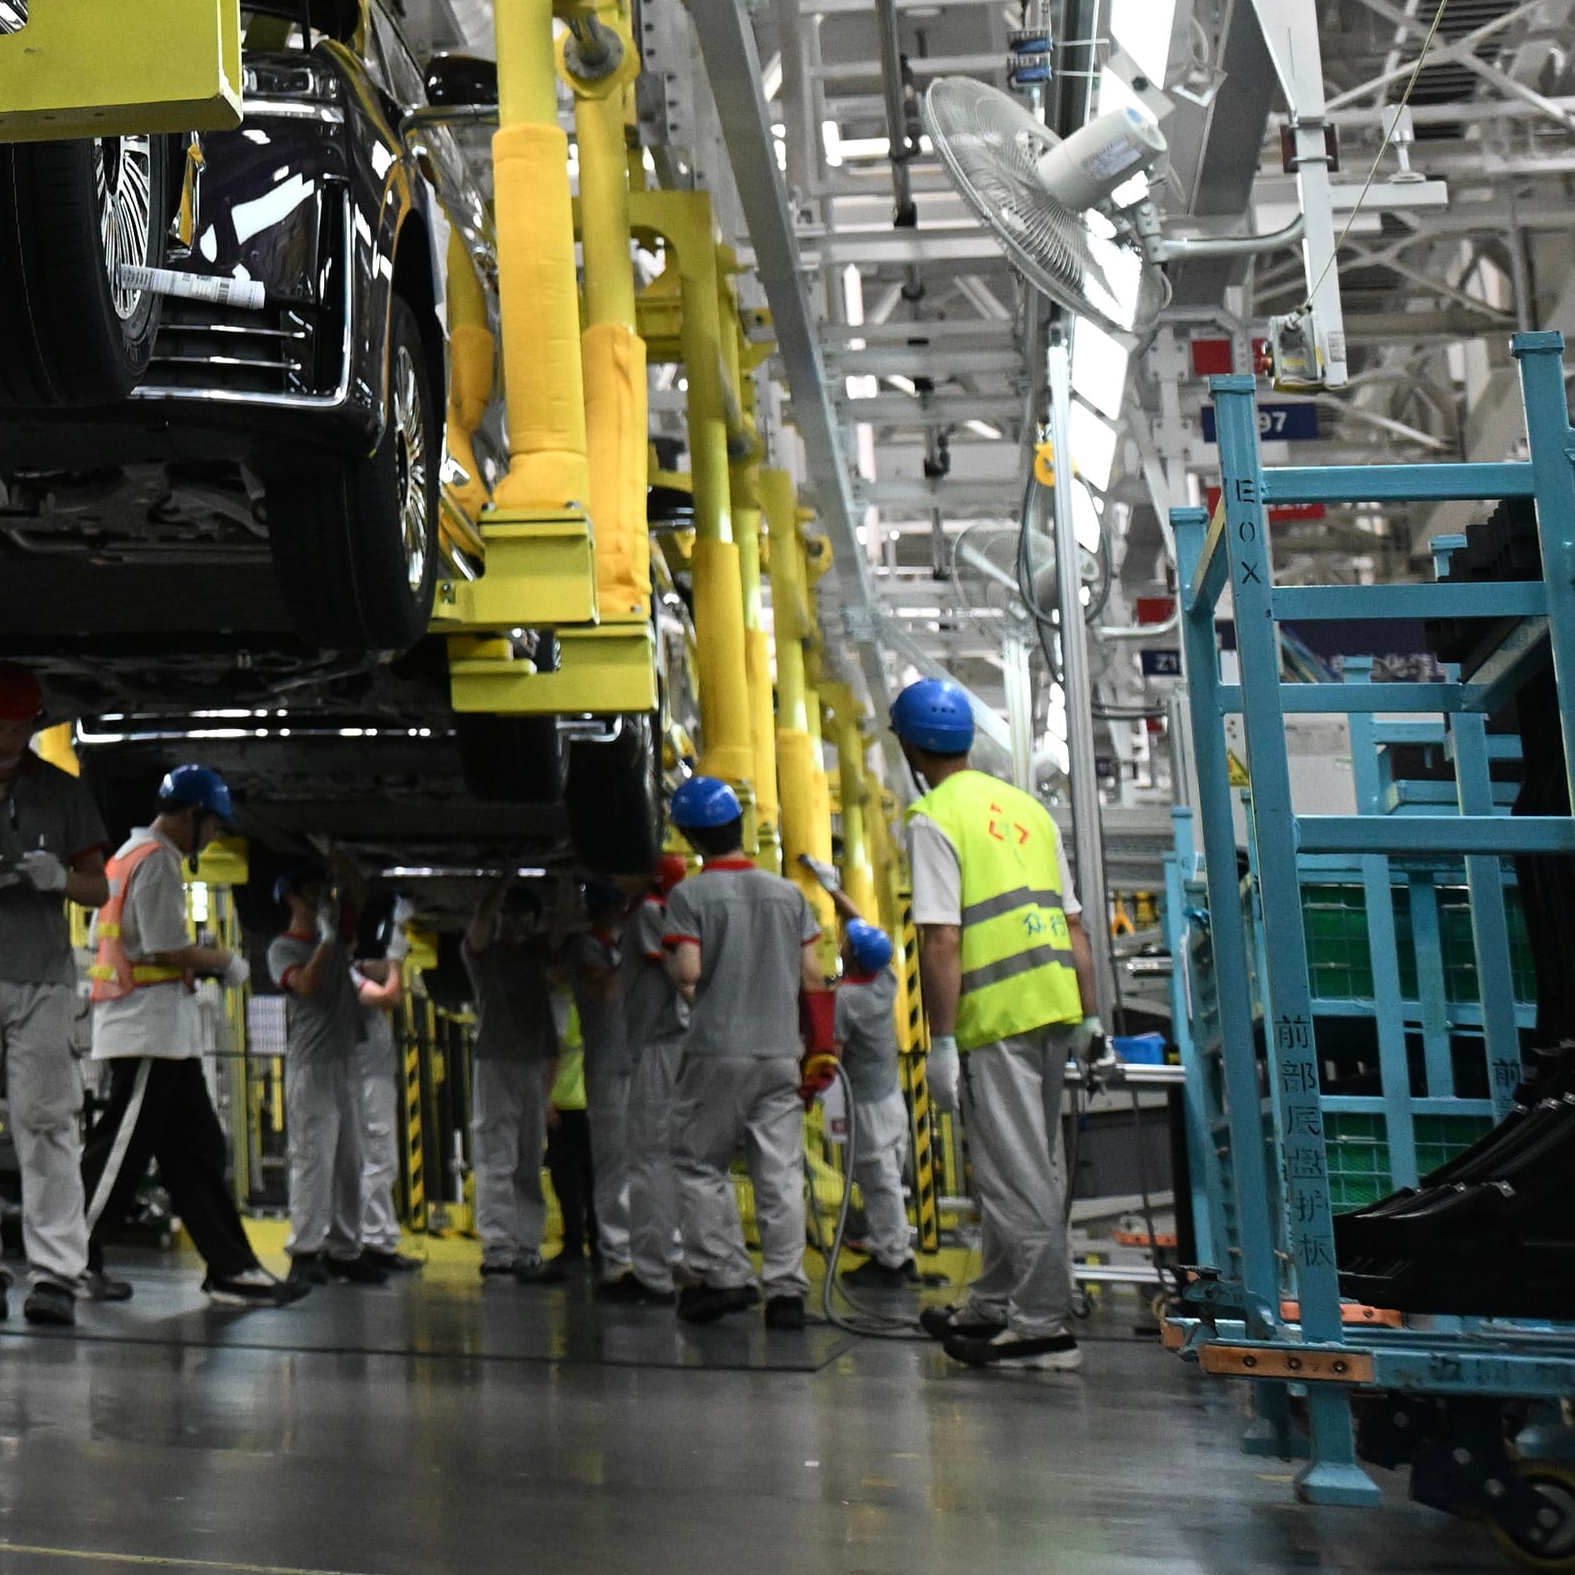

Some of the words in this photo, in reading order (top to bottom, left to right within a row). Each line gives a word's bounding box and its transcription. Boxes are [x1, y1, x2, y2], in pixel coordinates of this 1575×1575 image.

[1274, 1014, 1333, 1267] 前部底盘护板
